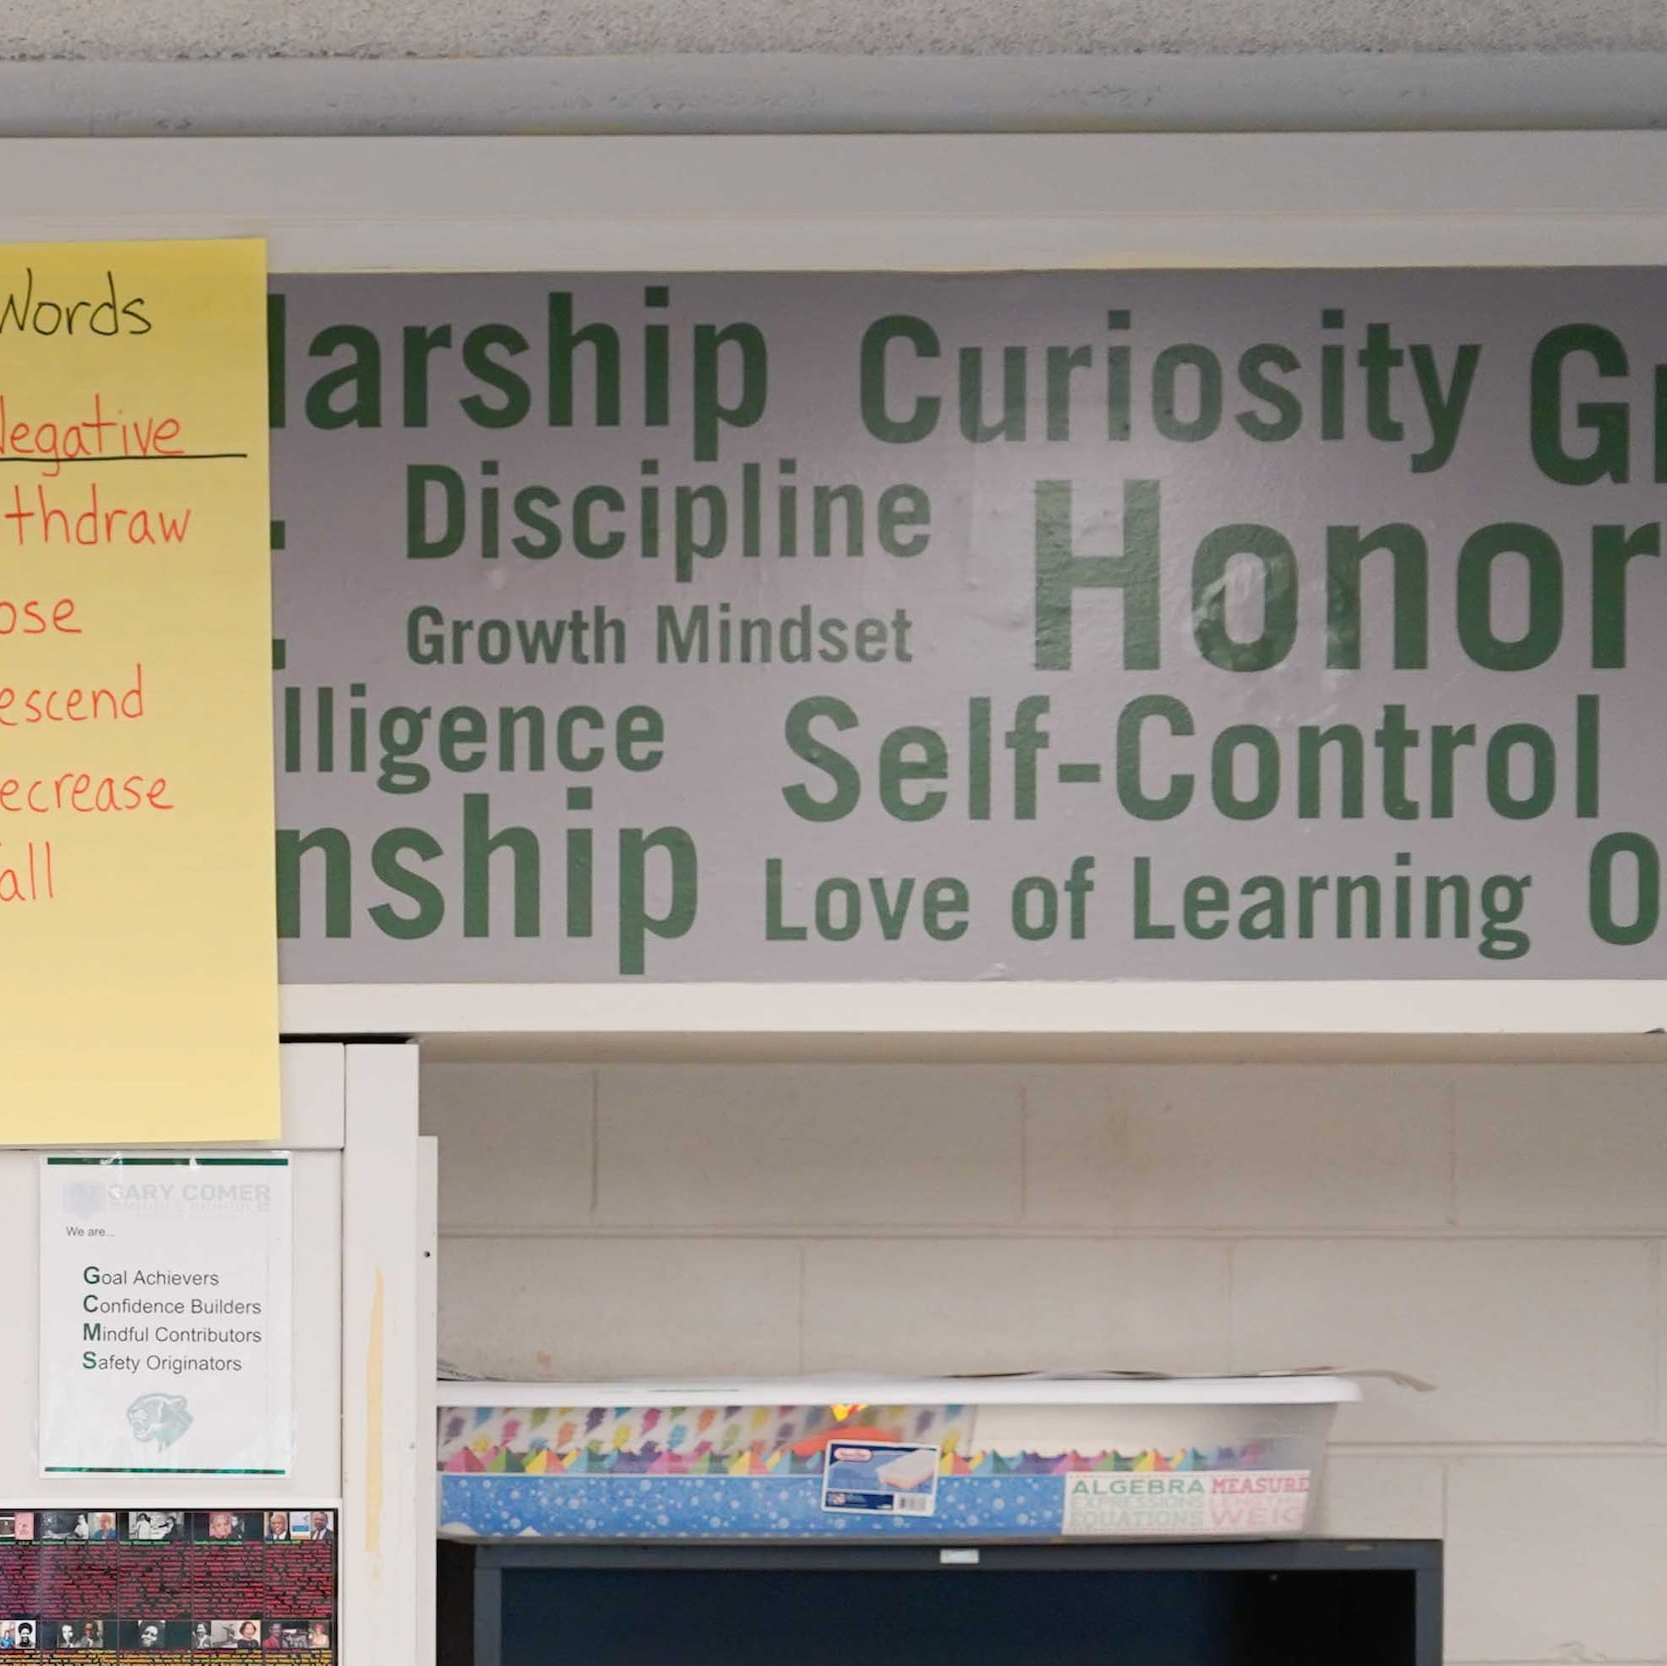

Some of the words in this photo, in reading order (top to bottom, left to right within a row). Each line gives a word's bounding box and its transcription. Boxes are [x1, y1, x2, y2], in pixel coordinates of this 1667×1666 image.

[859, 308, 1482, 475] Curiosity
[406, 458, 932, 583] Discipline
[1034, 477, 1662, 674] Honor
[406, 604, 627, 666] Growth
[655, 602, 914, 665] Mindset
[283, 682, 666, 795] lligence
[781, 693, 1601, 822] Self-Control
[765, 858, 970, 942] Love
[1009, 856, 1096, 941] of
[1132, 852, 1533, 961] Learning
[65, 1226, 85, 1238] We
[83, 1266, 127, 1286] Goal
[133, 1269, 220, 1287] Achievers
[83, 1294, 185, 1315] Confidence
[191, 1298, 262, 1315] Builders
[82, 1322, 149, 1343] Mindful
[155, 1325, 262, 1344] Contributors
[82, 1351, 141, 1375] Safety
[146, 1354, 243, 1376] Originators
[1071, 1479, 1205, 1496] ALGEBRA
